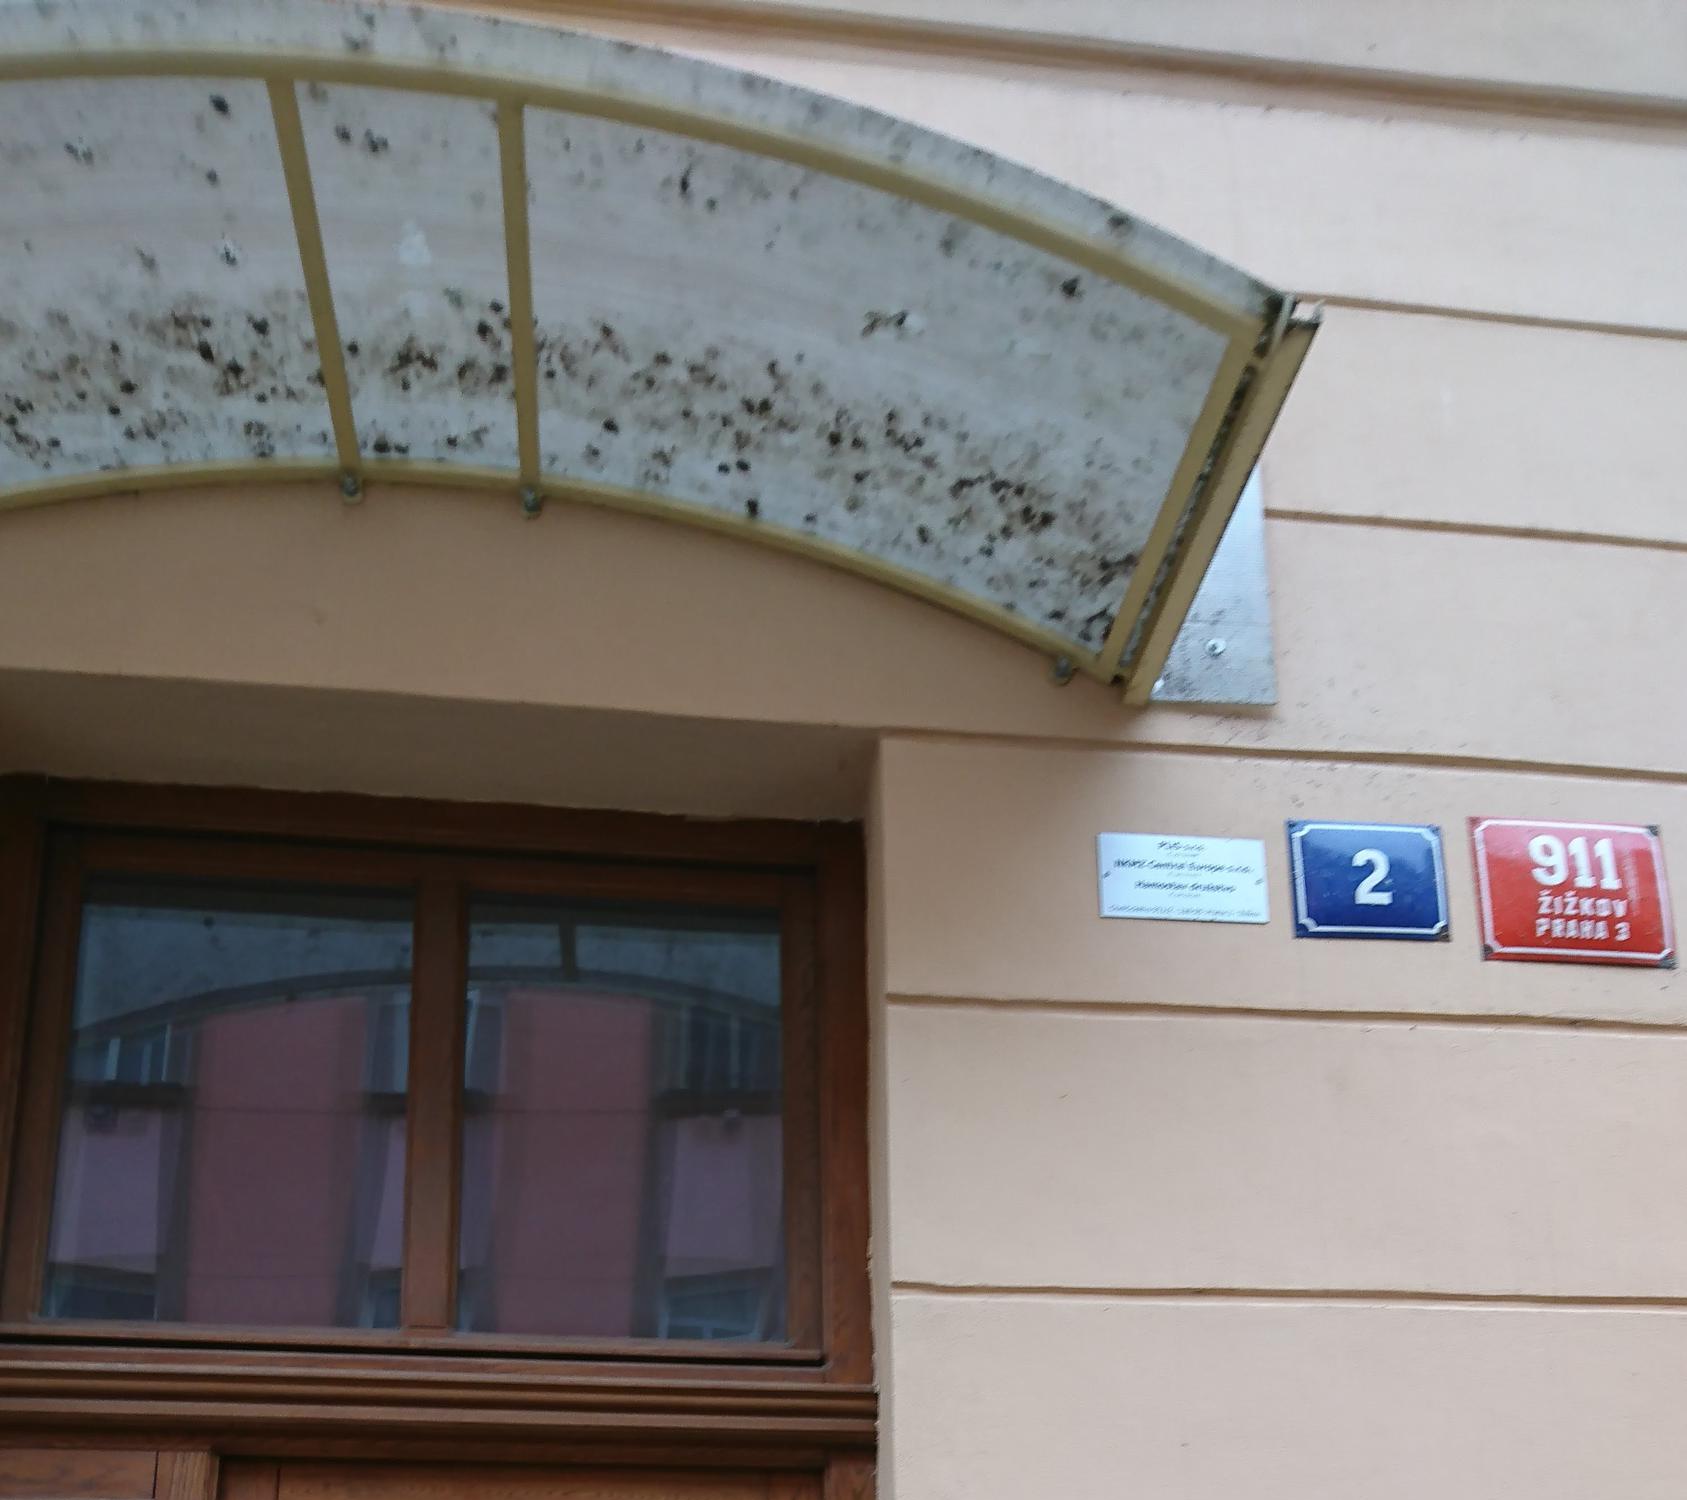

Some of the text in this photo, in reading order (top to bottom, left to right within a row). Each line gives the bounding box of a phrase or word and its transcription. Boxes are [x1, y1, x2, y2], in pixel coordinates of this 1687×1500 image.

[1351, 848, 1393, 906] 2
[1528, 834, 1622, 890] 911
[1537, 889, 1628, 918] ŽIŽKOV
[1535, 917, 1631, 941] PRAHA 3
